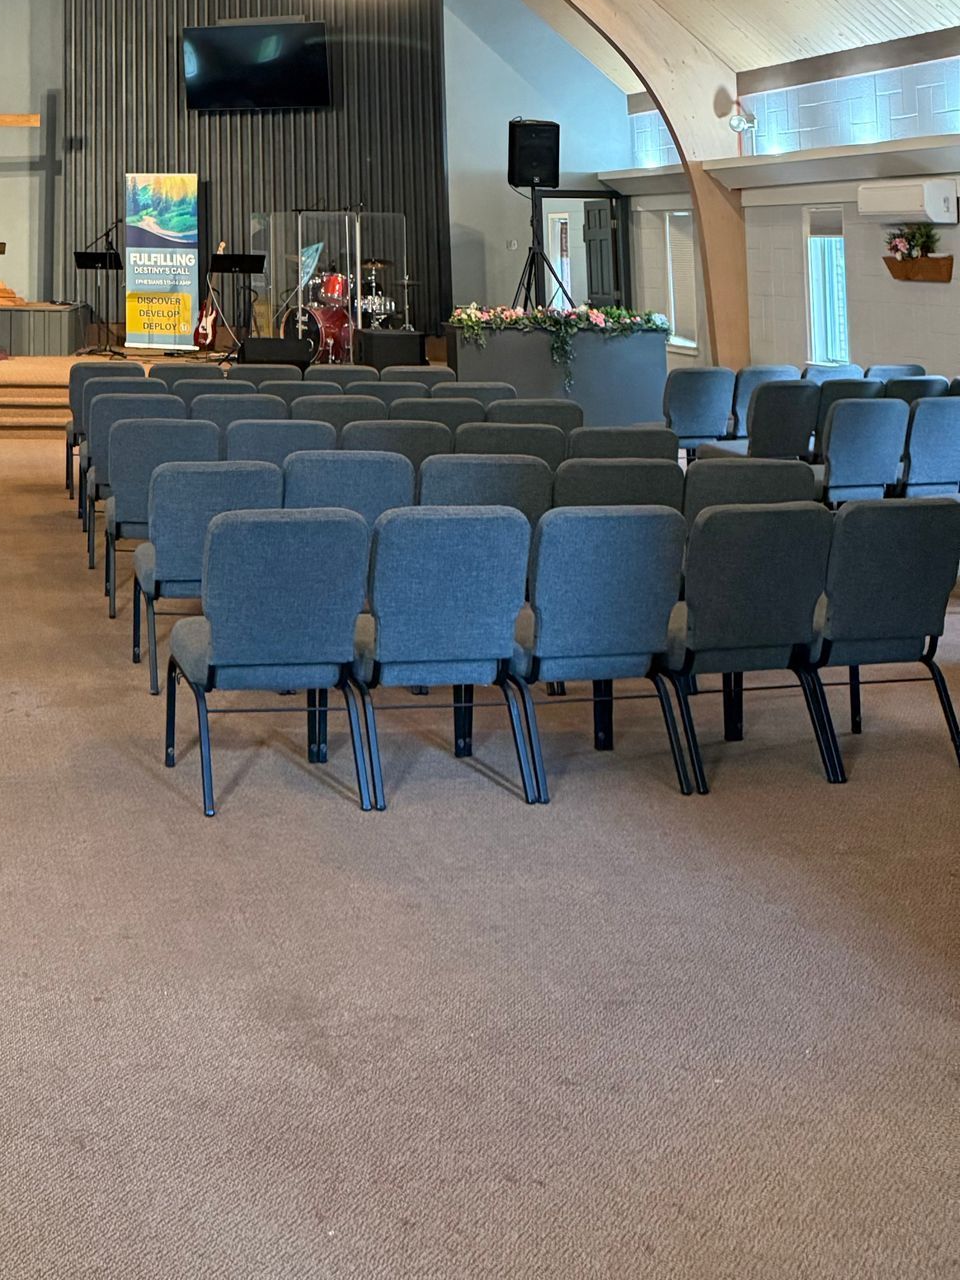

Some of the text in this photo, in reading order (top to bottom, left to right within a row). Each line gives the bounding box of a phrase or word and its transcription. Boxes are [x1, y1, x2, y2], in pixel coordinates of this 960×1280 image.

[130, 253, 195, 266] FULFILLING
[134, 266, 190, 275] DESTINY'S CALL
[137, 296, 181, 305] DISCOVER
[139, 309, 180, 318] DEVELOP
[143, 322, 177, 330] DEPLOY
